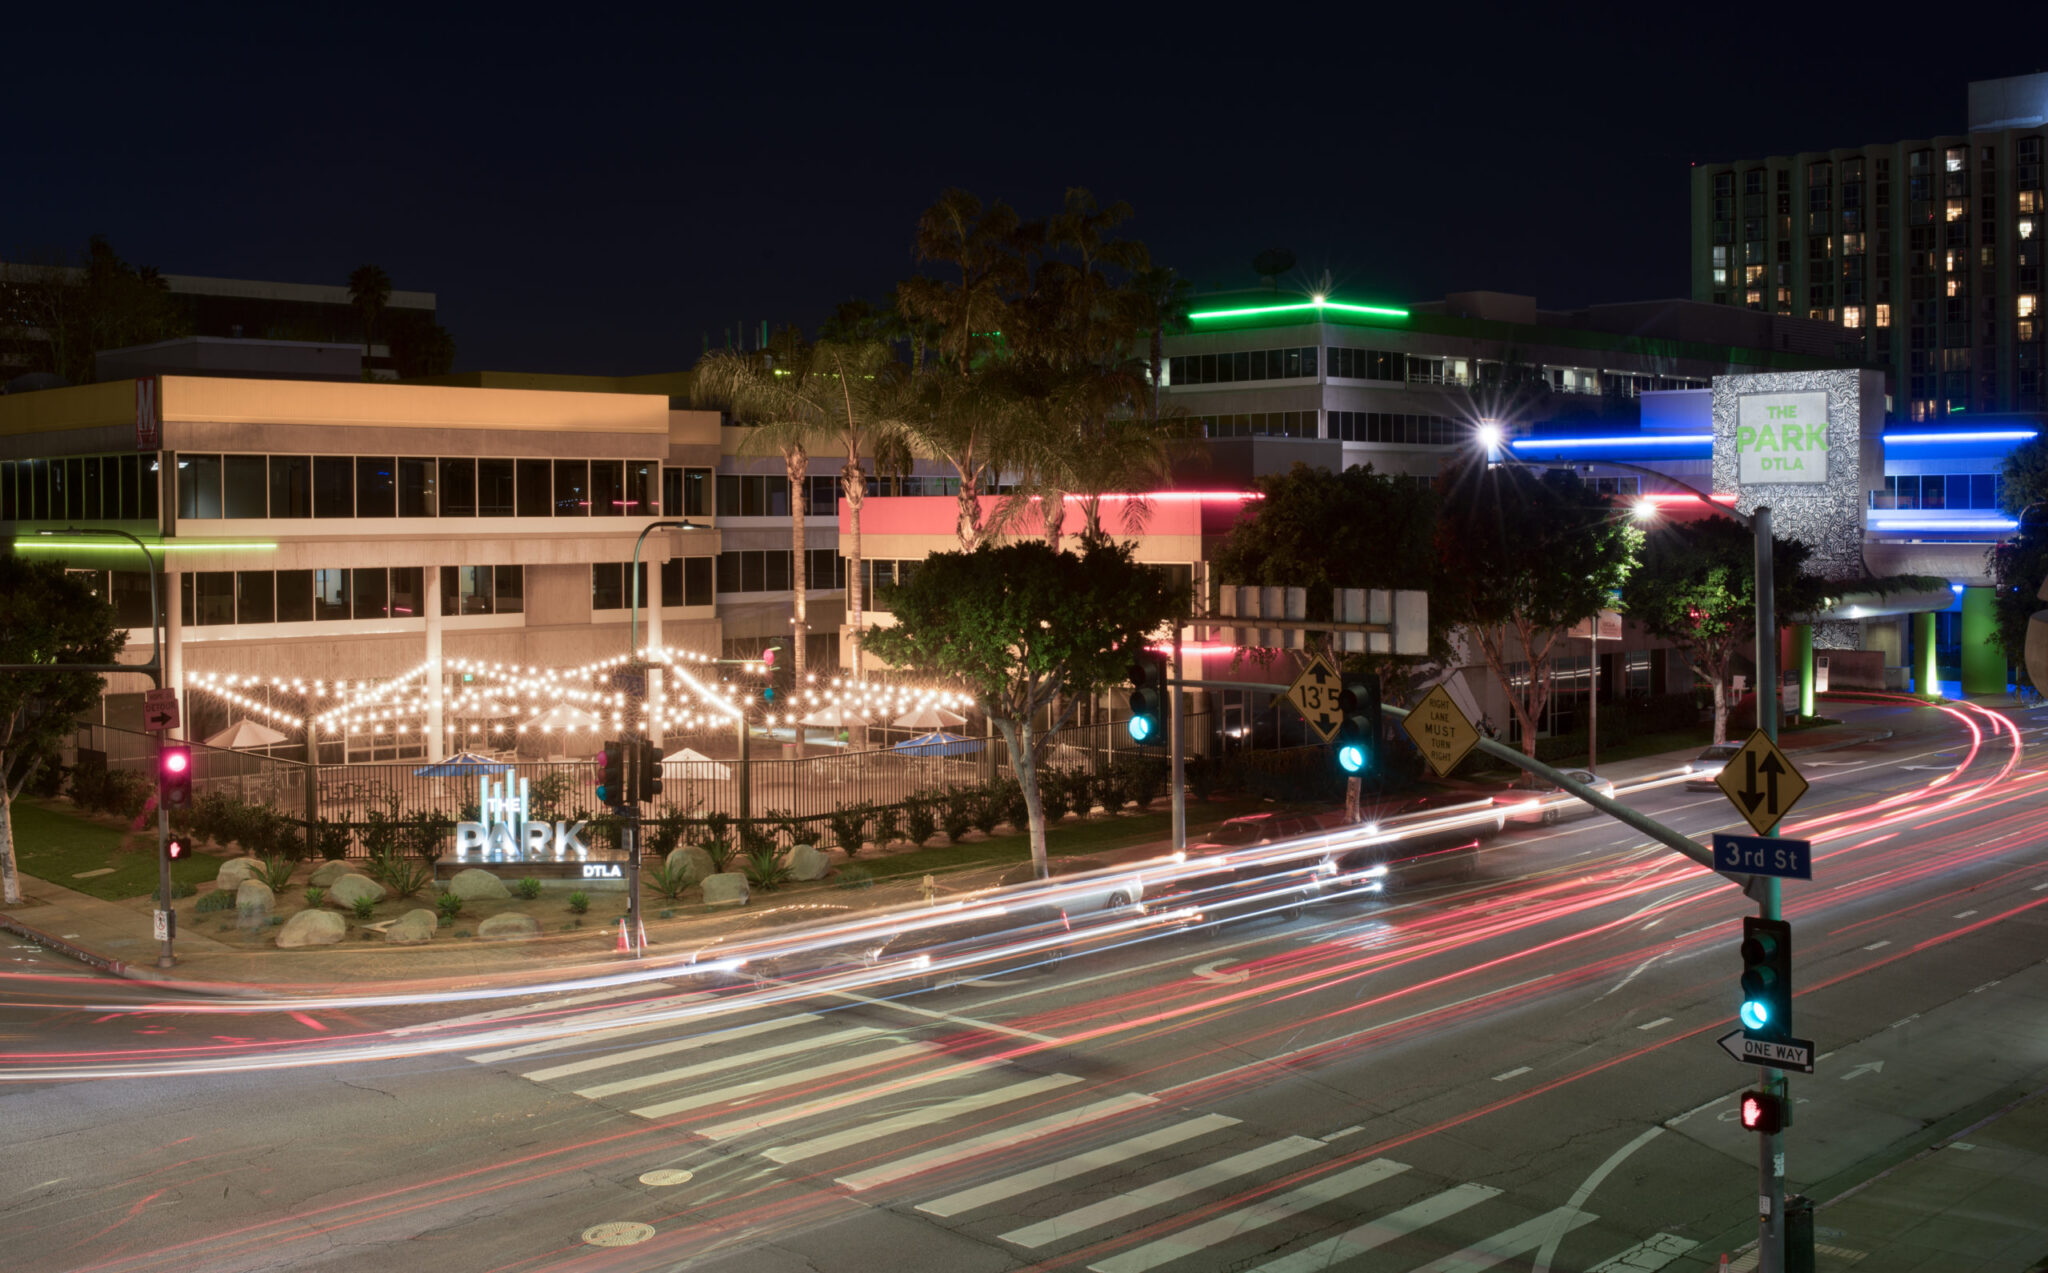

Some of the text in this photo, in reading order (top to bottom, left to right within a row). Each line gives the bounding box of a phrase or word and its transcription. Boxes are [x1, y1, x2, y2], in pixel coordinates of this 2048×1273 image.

[1766, 405, 1797, 419] THE
[1736, 423, 1829, 453] PARK
[1761, 457, 1803, 470] DTLA
[1429, 698, 1449, 710] RIGHT
[1430, 711, 1449, 722] LANE
[1425, 723, 1455, 738] MUST
[1432, 738, 1450, 749] TURN
[1431, 750, 1451, 761] RIGHT
[487, 798, 520, 813] THE
[456, 820, 588, 861] PARK
[1725, 841, 1798, 870] 3rd St
[583, 865, 622, 877] DTLA
[1744, 1041, 1803, 1062] ONE WAY
